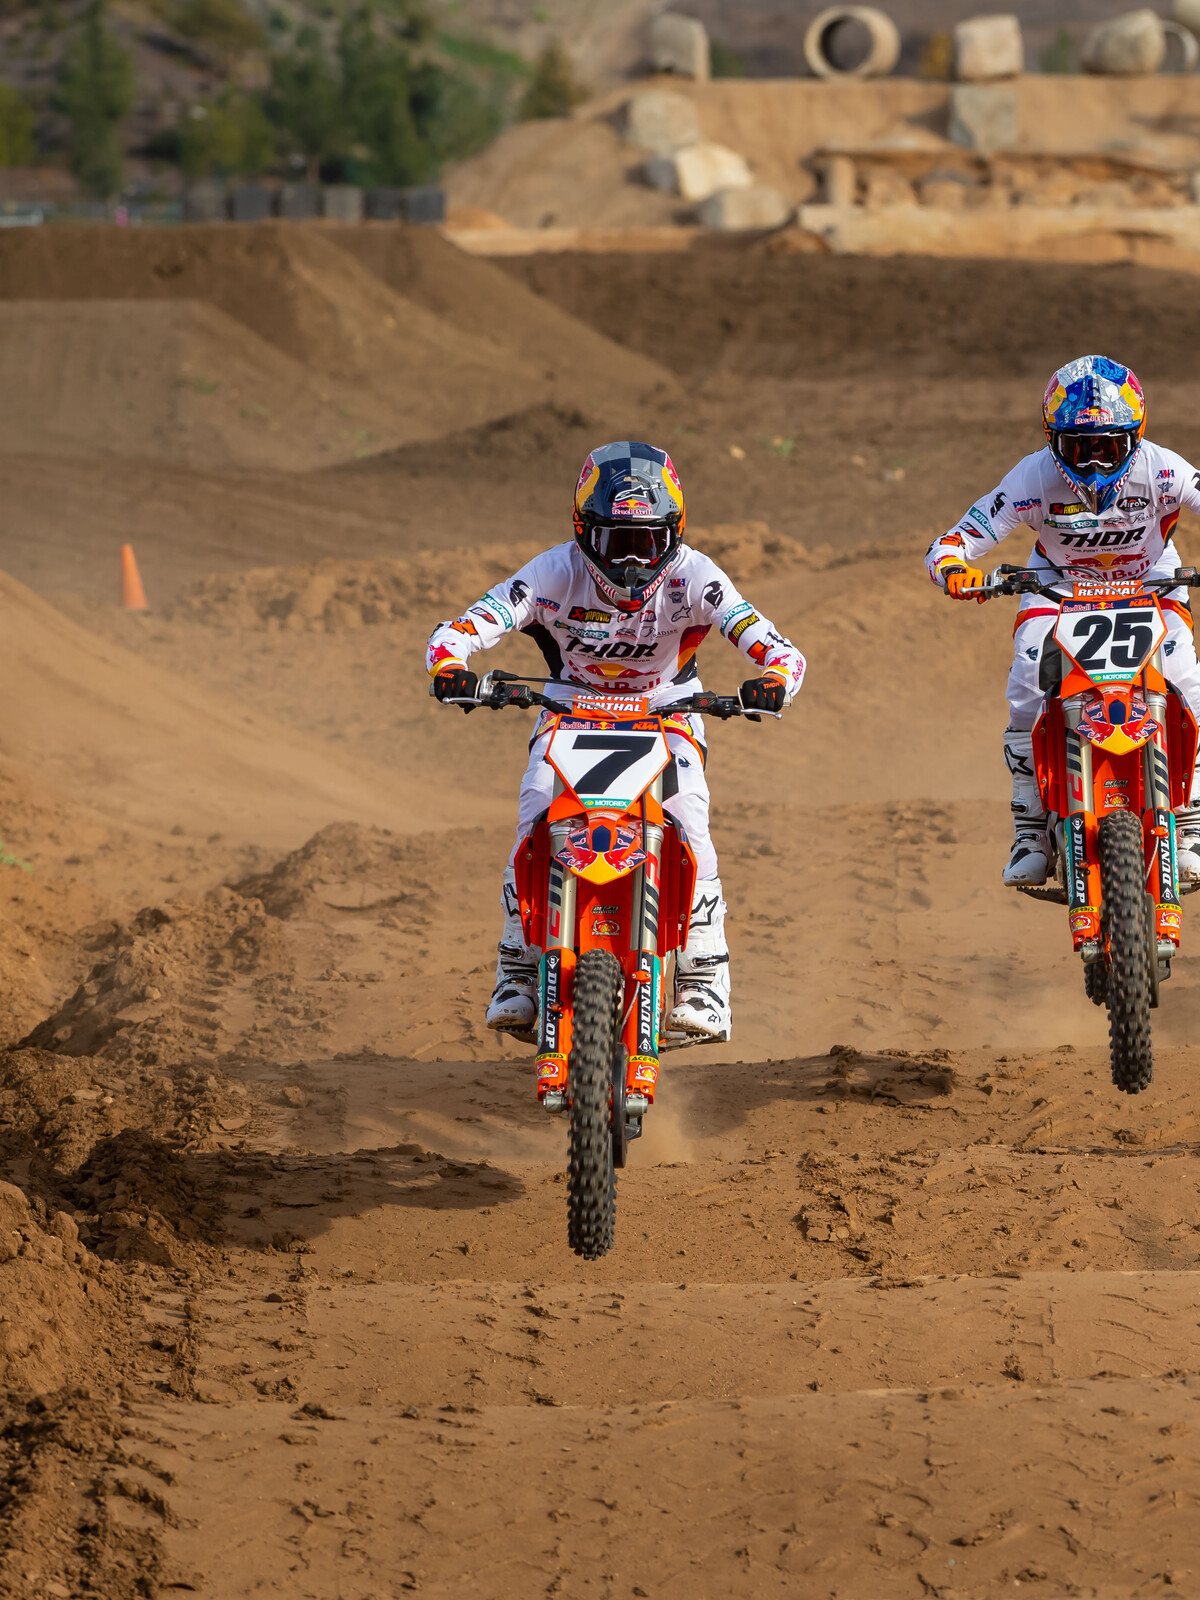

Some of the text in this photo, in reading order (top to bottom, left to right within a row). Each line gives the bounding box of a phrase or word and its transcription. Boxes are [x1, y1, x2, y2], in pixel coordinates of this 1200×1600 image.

[1057, 520, 1094, 529] MOTOREX
[1059, 526, 1146, 547] THOR
[1078, 587, 1137, 597] RENTHAL
[1129, 598, 1153, 607] KTM
[1073, 611, 1153, 671] 25
[577, 702, 643, 712] RENTHAL
[632, 721, 658, 730] KTM
[572, 735, 657, 794] 7
[1159, 814, 1171, 887] DUNLP
[641, 958, 651, 1037] DUNLP
